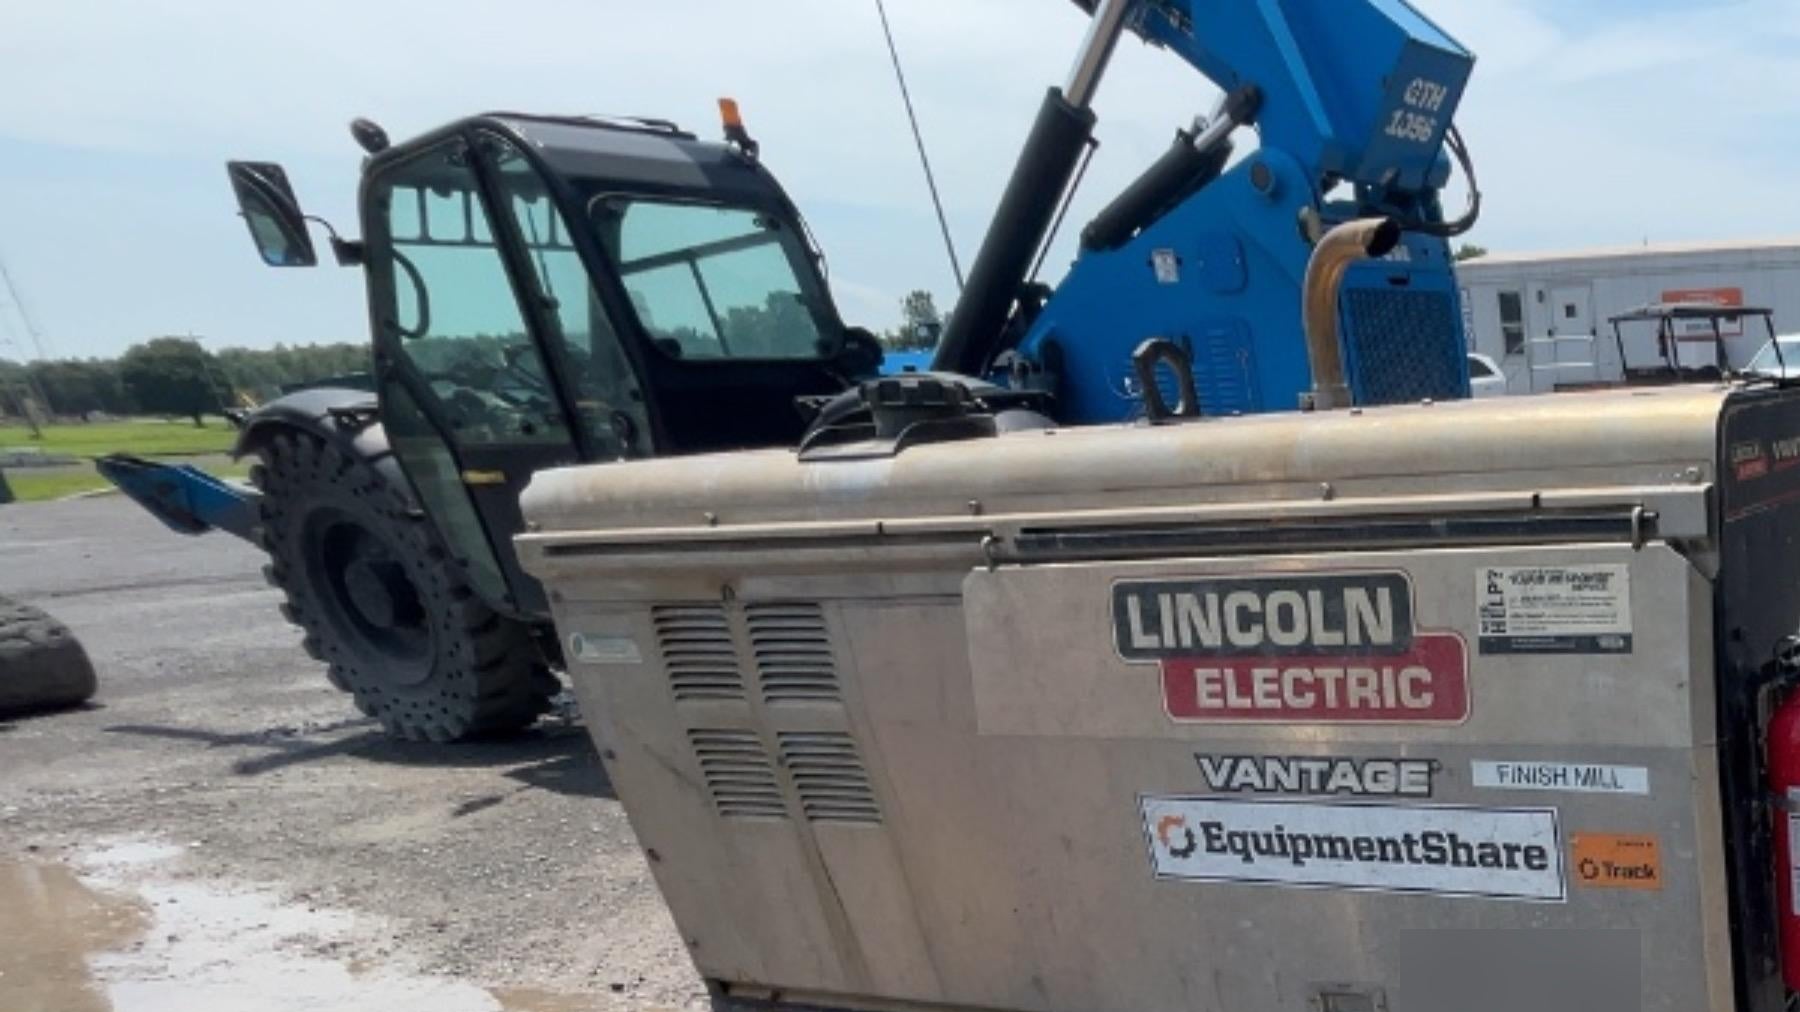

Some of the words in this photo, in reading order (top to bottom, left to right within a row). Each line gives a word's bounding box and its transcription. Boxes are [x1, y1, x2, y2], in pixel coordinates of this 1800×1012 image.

[1126, 586, 1394, 649] LINCOLN
[1194, 665, 1434, 709] ELECTRIC
[1195, 753, 1434, 797] VANTAGE
[1496, 764, 1567, 787] FINISH
[1574, 767, 1624, 789] MILL
[1200, 820, 1549, 871] EquipmentShare
